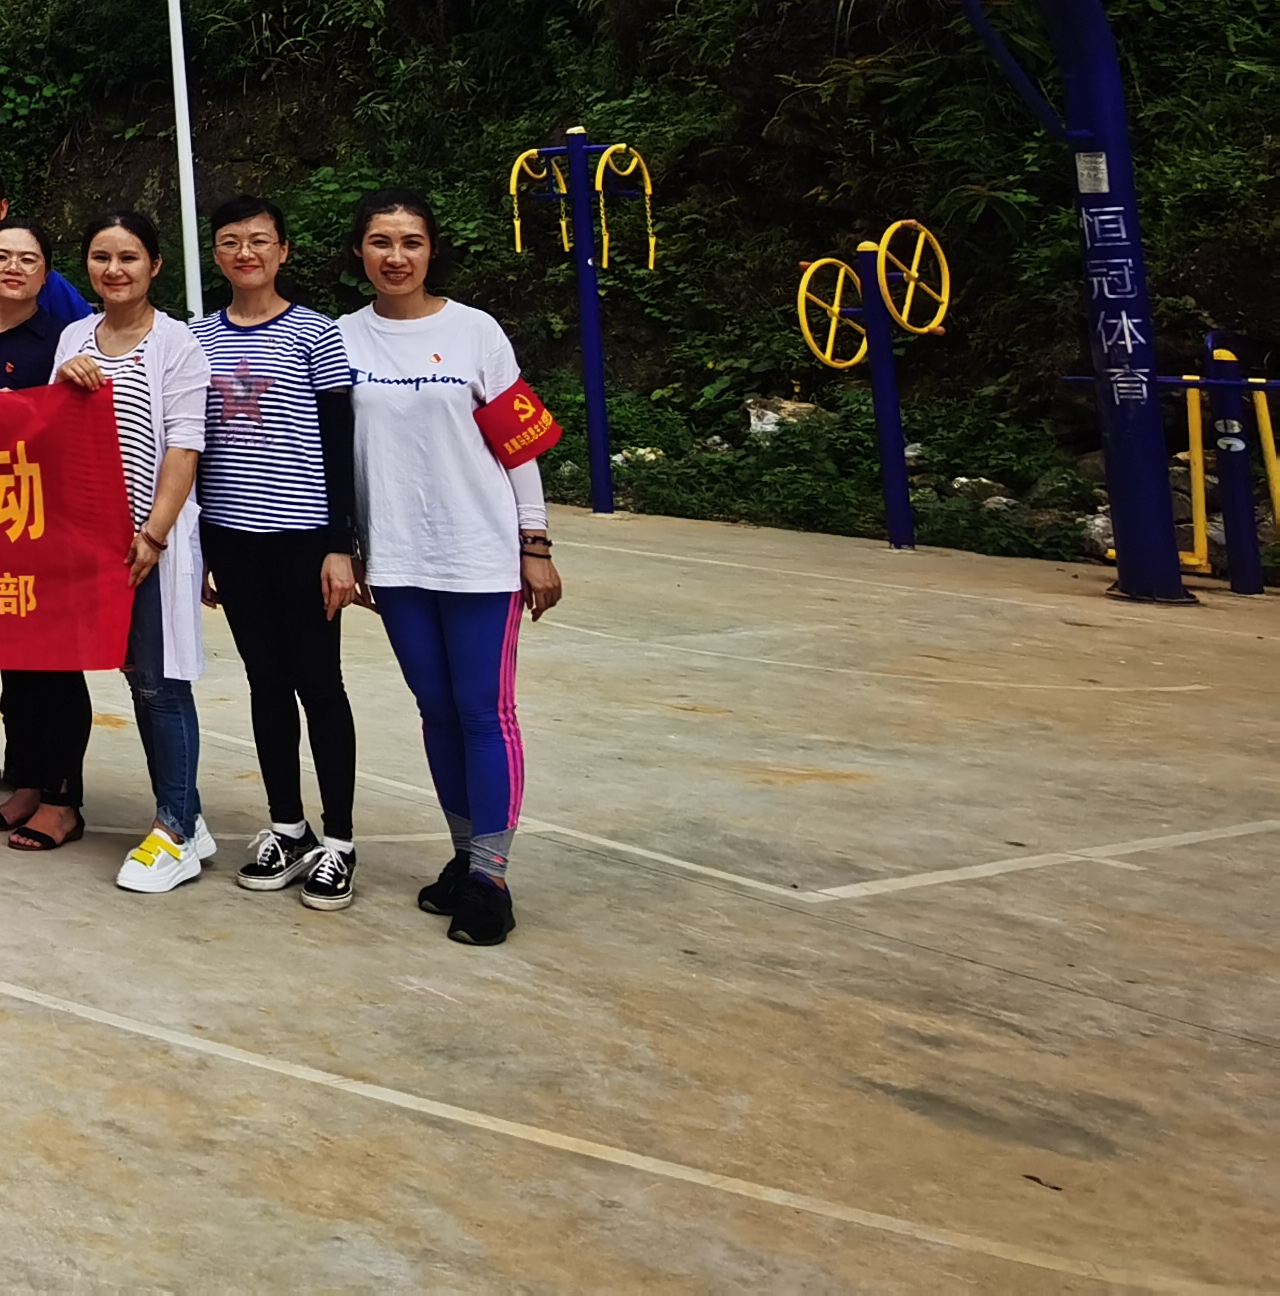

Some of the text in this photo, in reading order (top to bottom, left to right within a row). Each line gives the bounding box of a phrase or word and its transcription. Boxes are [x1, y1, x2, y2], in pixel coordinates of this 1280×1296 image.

[1080, 206, 1151, 405] 恒冠体育
[350, 368, 468, 391] Champion
